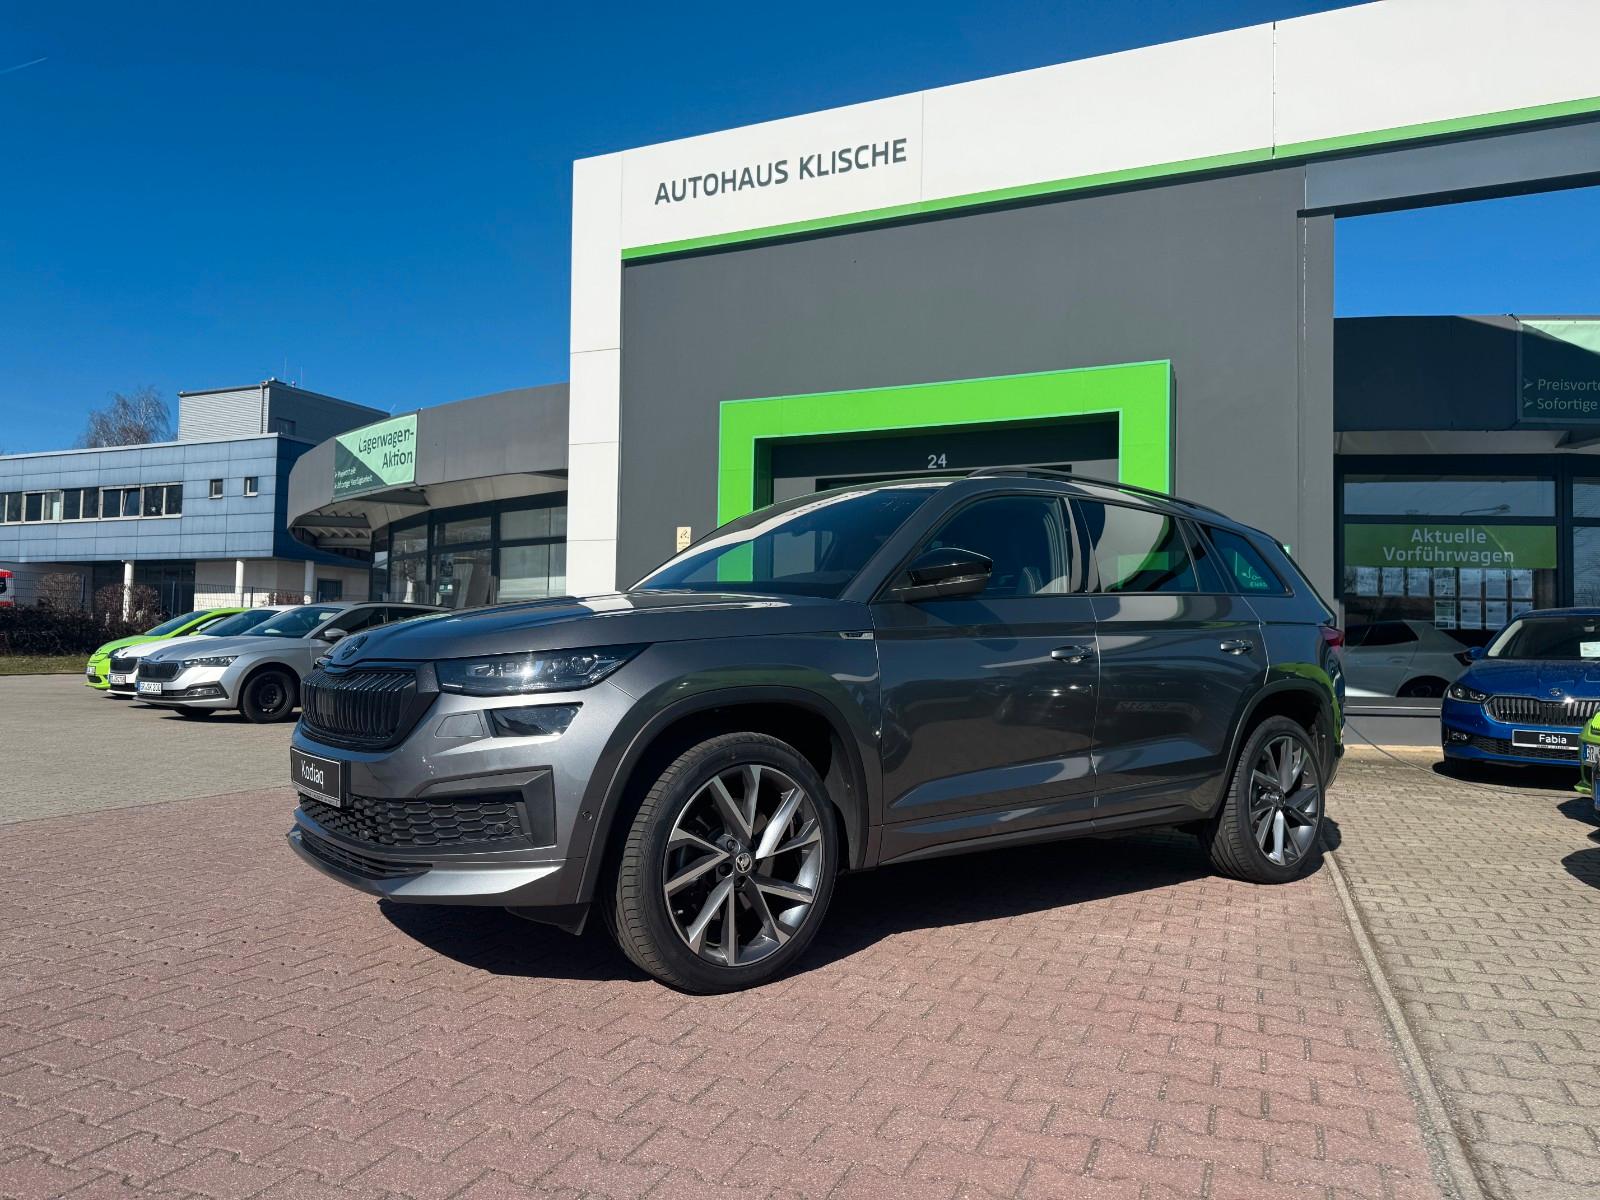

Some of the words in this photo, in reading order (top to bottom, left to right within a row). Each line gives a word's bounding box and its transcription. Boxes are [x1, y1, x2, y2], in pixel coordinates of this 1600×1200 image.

[654, 160, 788, 205] AUTOHAUS
[799, 138, 907, 180] KLISCHE
[1537, 397, 1598, 412] Sofortige
[358, 428, 414, 455] Lagerwagen-
[382, 449, 413, 469] Aktion
[927, 453, 947, 469] 24
[1411, 528, 1487, 543] Aktuelle
[1383, 546, 1514, 566] Vorführwagen
[1538, 733, 1567, 745] Fabia
[301, 759, 324, 790] Kodiaq
